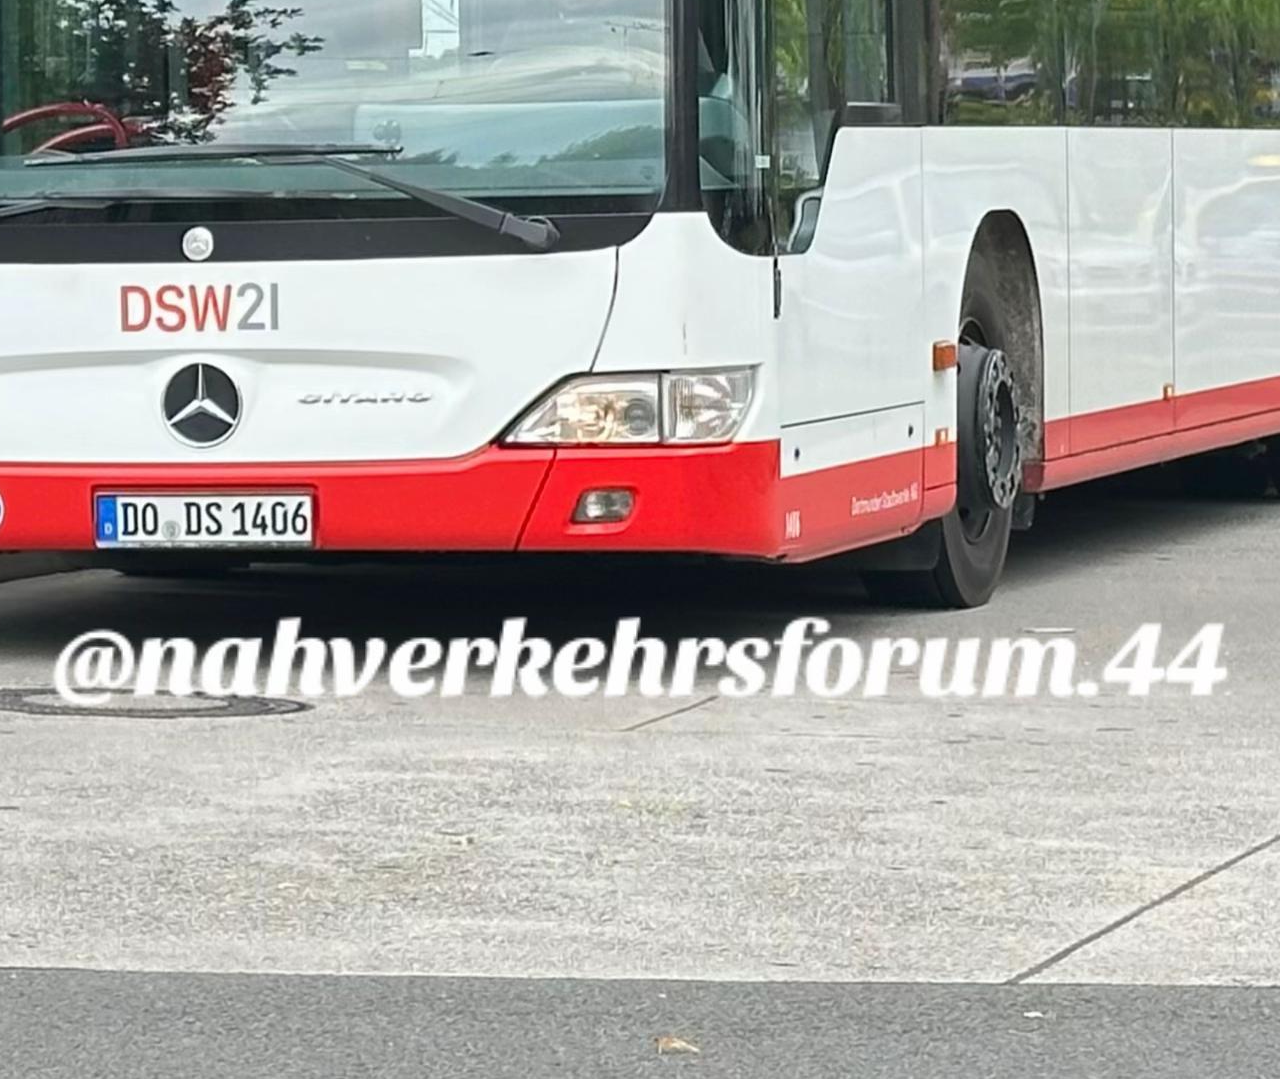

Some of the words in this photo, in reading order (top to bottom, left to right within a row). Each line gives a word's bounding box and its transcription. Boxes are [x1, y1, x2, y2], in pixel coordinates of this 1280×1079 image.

[122, 502, 158, 536] DO
[184, 502, 222, 536] DS
[231, 501, 308, 536] 1406
